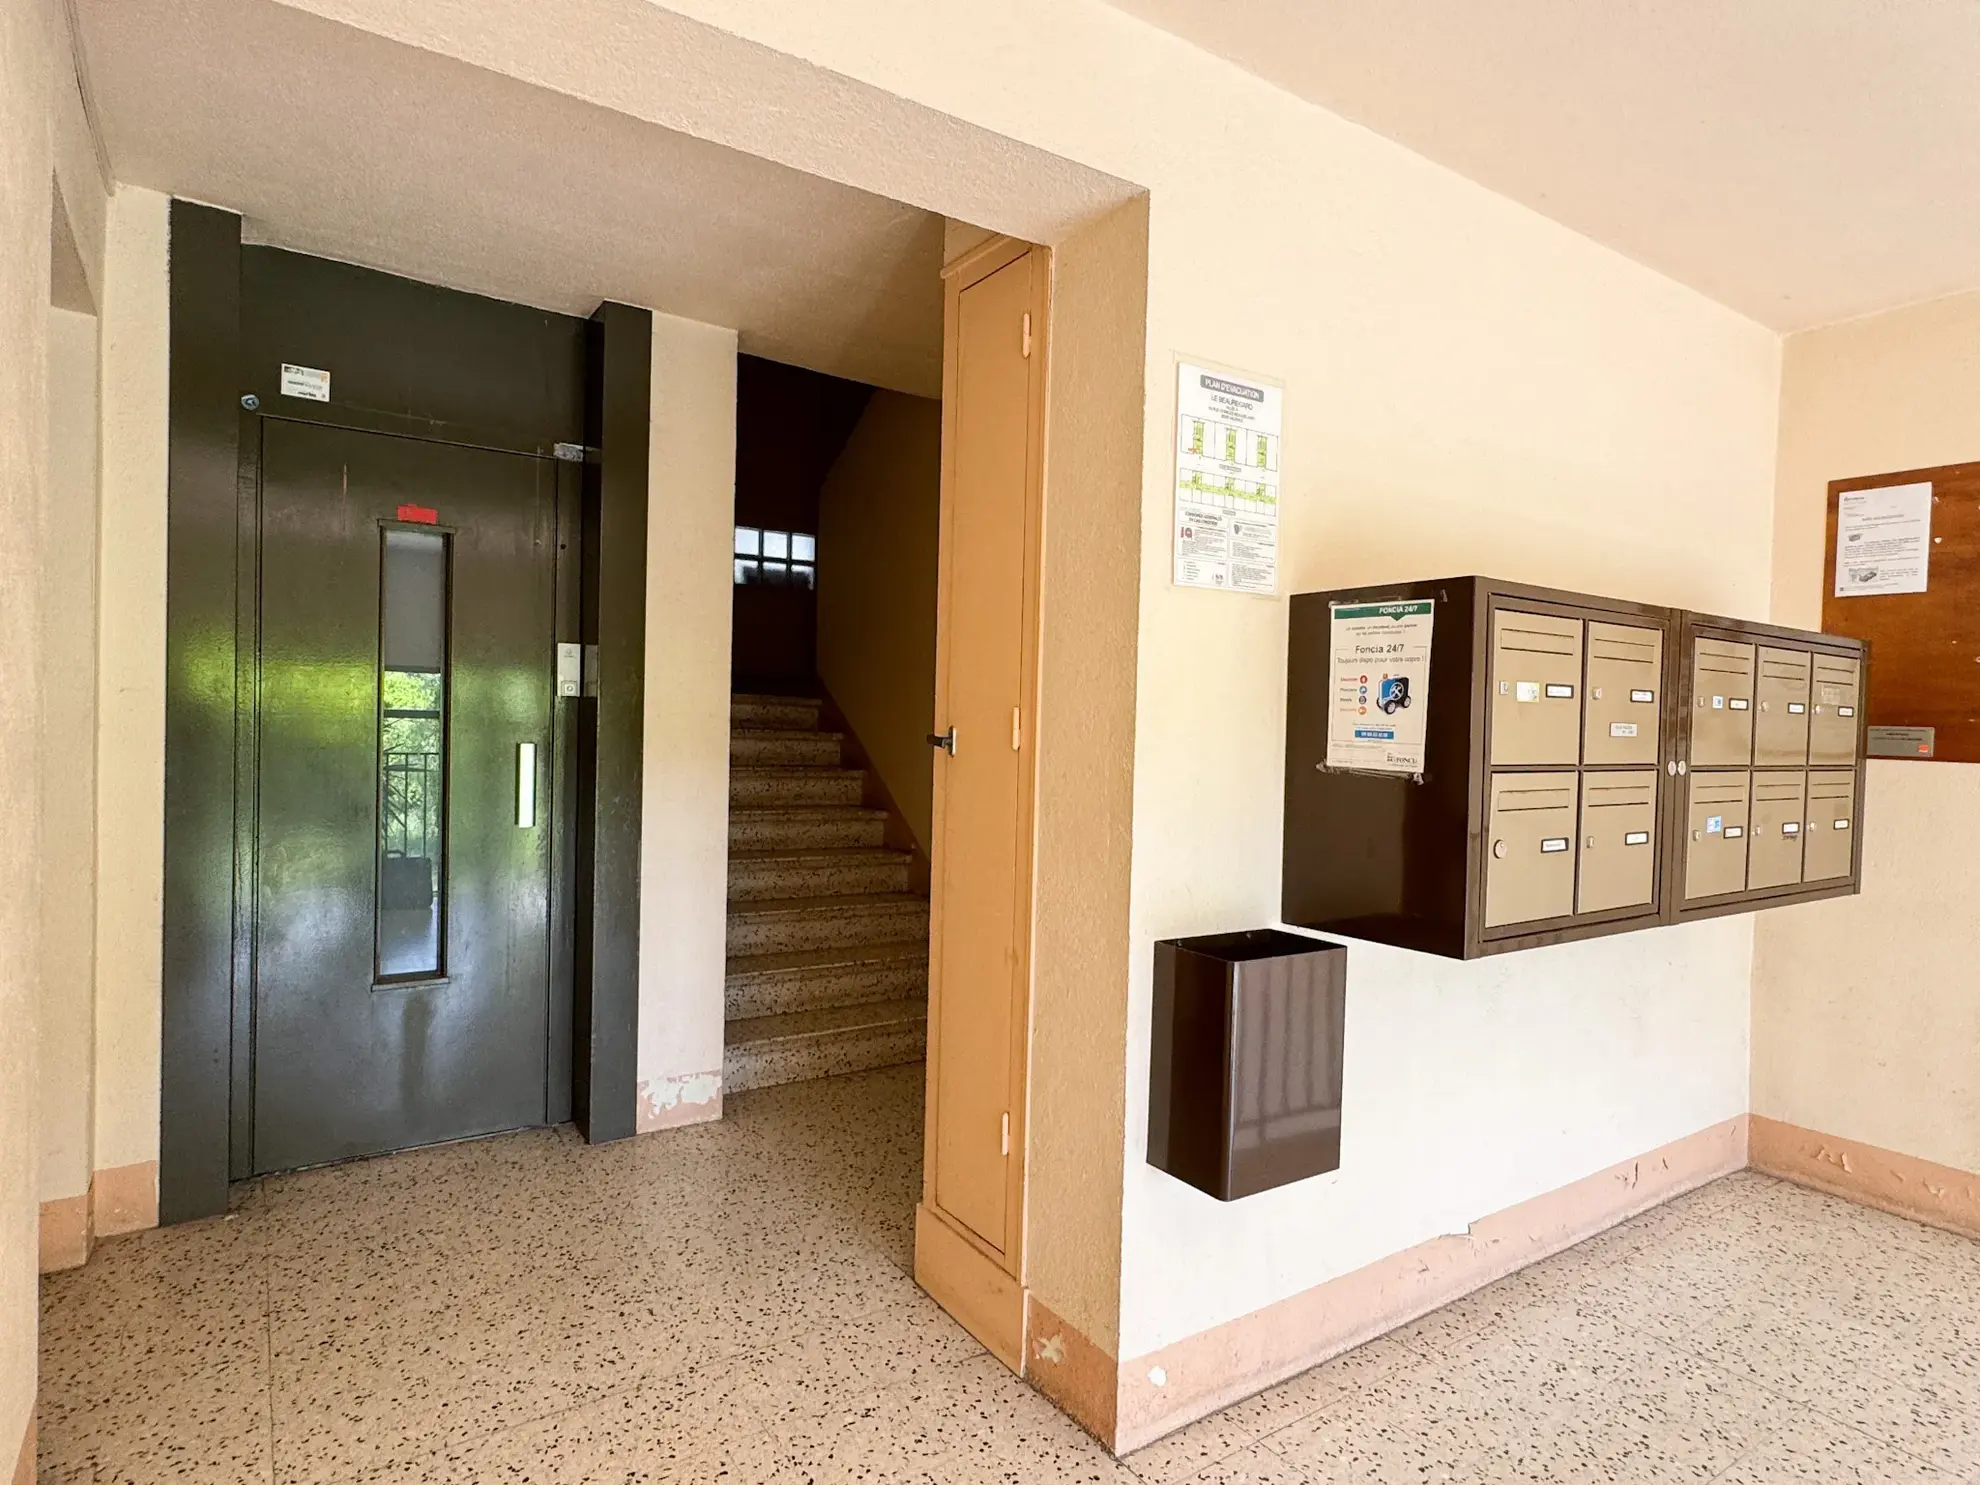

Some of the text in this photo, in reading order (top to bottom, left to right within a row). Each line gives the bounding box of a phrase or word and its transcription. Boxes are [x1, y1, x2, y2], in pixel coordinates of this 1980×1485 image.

[1205, 378, 1220, 390] PLAN
[1379, 605, 1418, 615] FONCIA 24/7
[1355, 644, 1405, 654] Foncia 24/7
